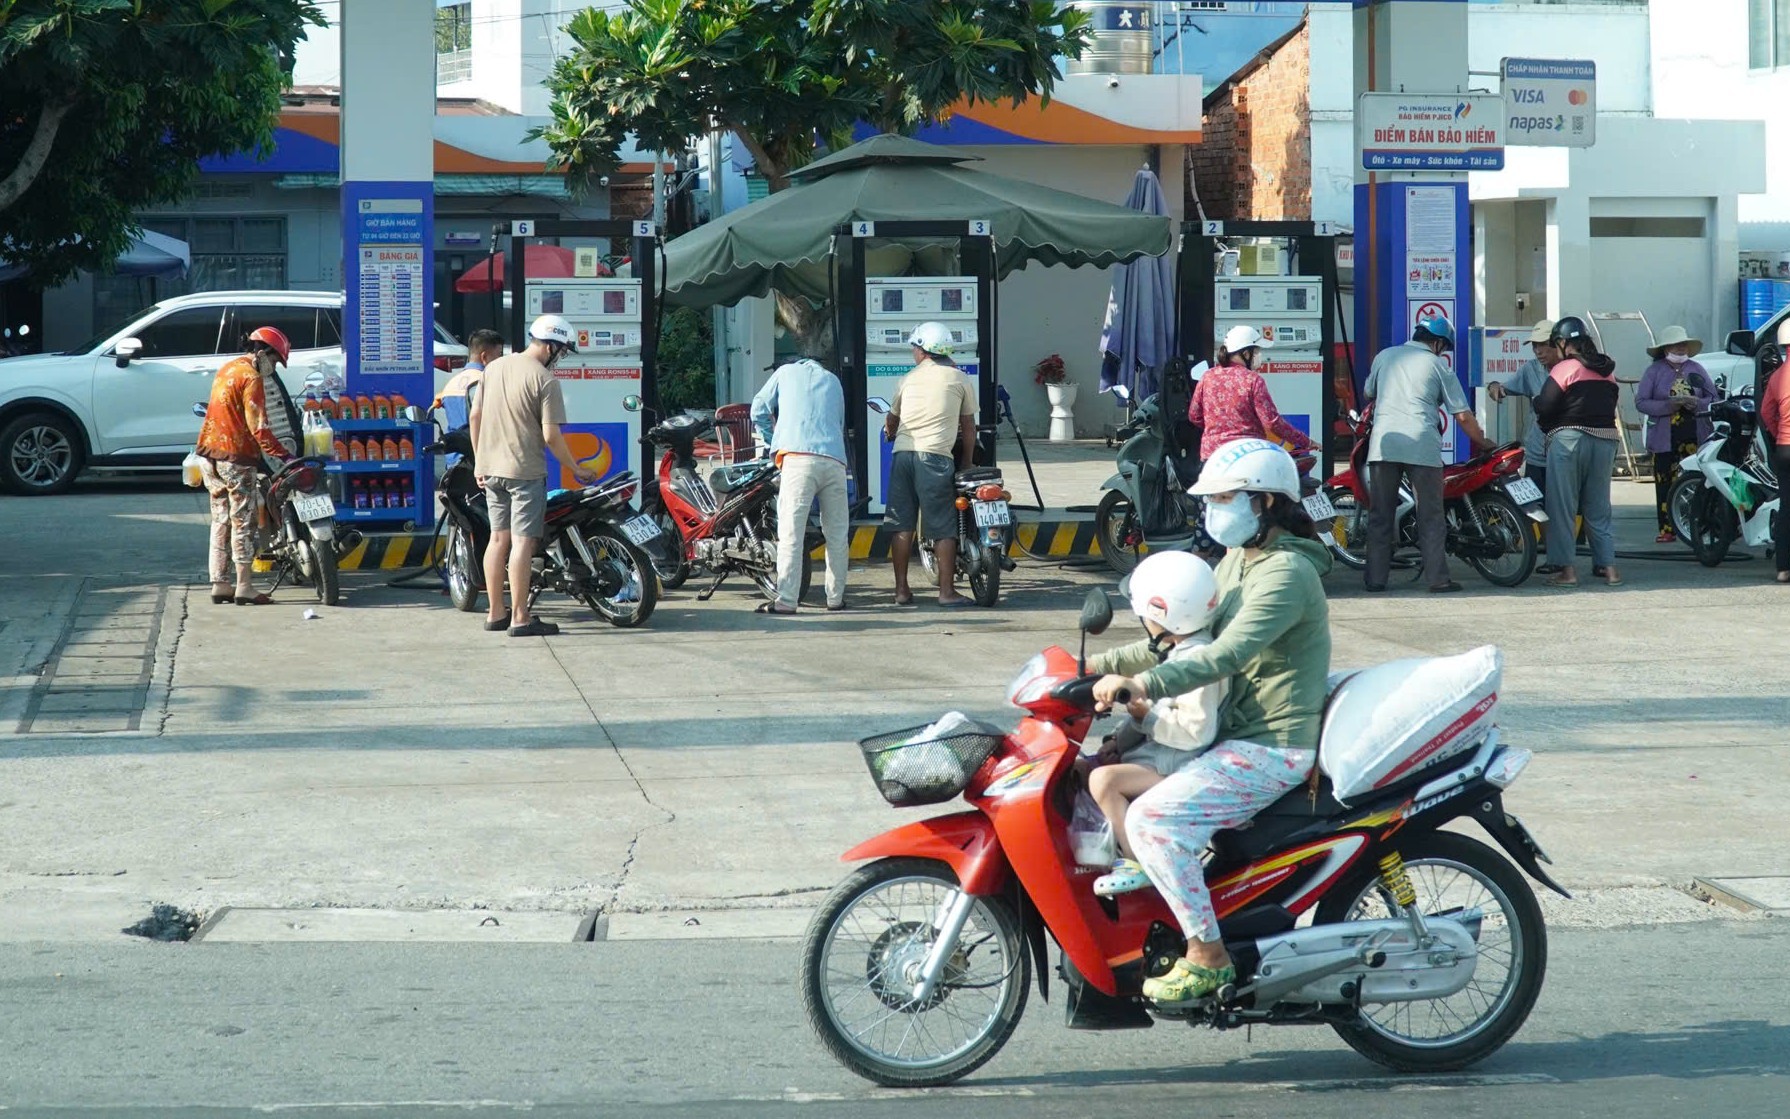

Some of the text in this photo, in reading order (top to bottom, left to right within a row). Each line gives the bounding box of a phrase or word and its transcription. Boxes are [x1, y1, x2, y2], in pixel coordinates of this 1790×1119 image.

[1508, 62, 1527, 72] CHẤP
[1549, 66, 1574, 74] THANH
[1575, 65, 1594, 75] TOÁN
[1511, 88, 1545, 104] VISA
[1509, 116, 1554, 134] napas
[1374, 124, 1496, 144] ĐIỂM BÁN BẢO HIỂM
[1404, 156, 1420, 166] máy
[1428, 156, 1442, 165] Sức
[1470, 157, 1481, 165] Tài
[397, 218, 416, 227] HÀNG
[519, 222, 527, 234] 6
[976, 222, 984, 233] 3
[1209, 223, 1217, 233] 2
[640, 223, 648, 234] 5
[859, 223, 867, 234] 4
[1321, 223, 1328, 234] 1
[985, 502, 997, 513] 70
